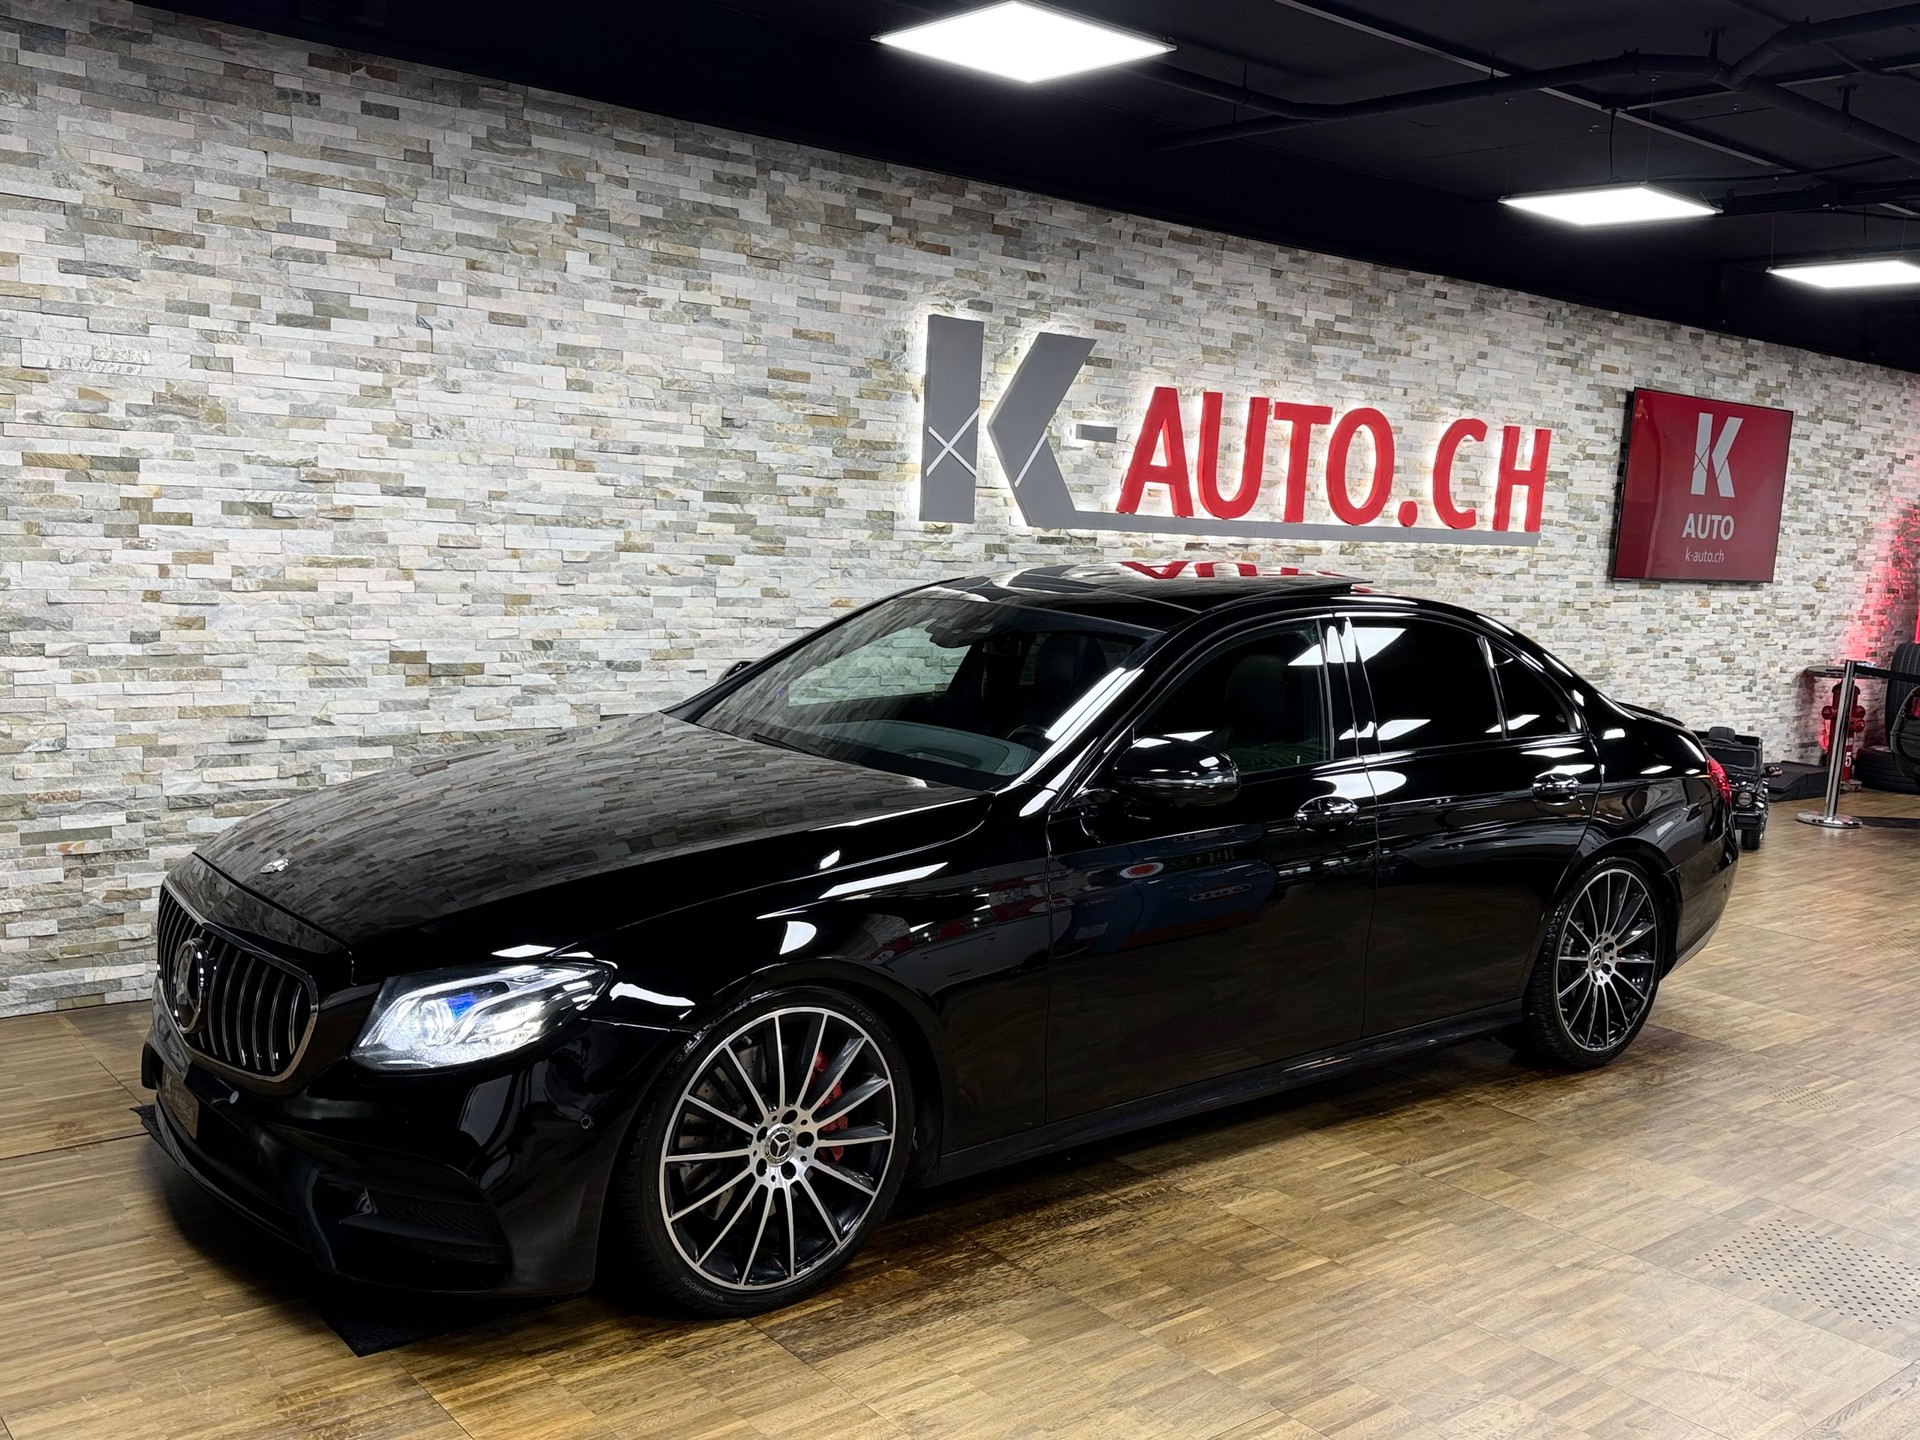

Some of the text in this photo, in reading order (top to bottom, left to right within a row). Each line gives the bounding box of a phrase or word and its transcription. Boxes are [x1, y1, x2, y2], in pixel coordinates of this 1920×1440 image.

[1690, 412, 1743, 498] K
[1682, 512, 1735, 541] AUTO
[1685, 546, 1725, 563] k-auto.ch
